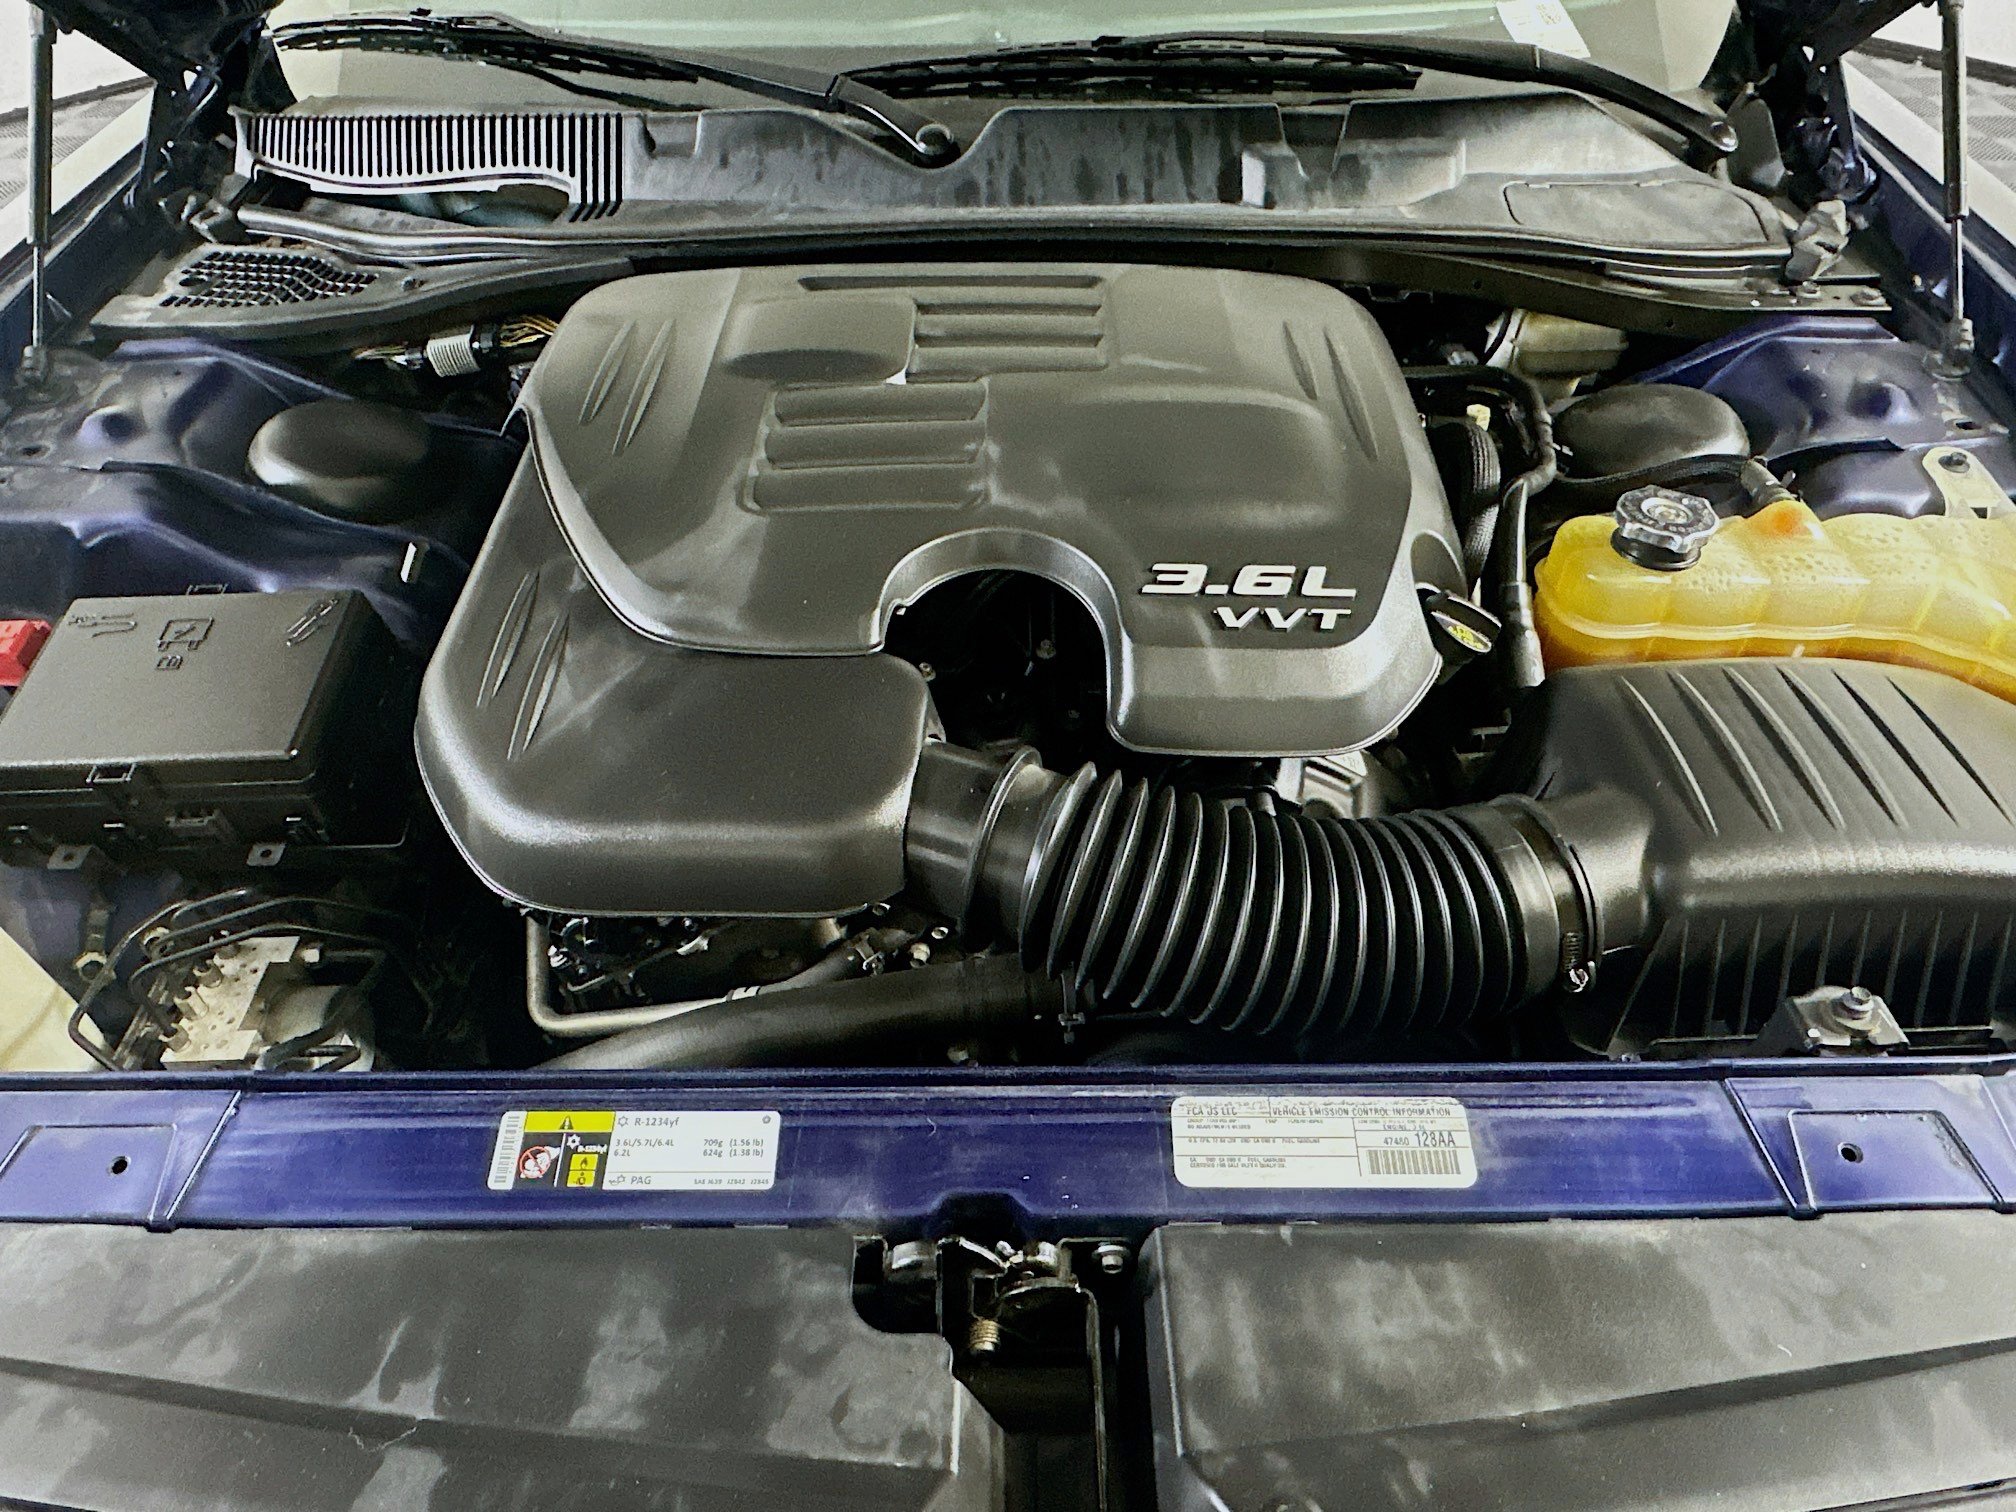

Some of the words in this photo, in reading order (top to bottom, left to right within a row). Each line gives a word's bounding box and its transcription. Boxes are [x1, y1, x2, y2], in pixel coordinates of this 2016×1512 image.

[1140, 563, 1357, 600] 3.6L
[1213, 606, 1352, 632] VVT
[1272, 1107, 1307, 1116] VEHICLE
[1309, 1107, 1349, 1116] EMISSION
[1352, 1106, 1389, 1117] CONTROL
[1392, 1107, 1451, 1116] INFORMATION
[634, 1116, 680, 1128] R-1234yf
[615, 1138, 674, 1148] 3.6L/5.7L/6.4L
[703, 1138, 723, 1148] 709g
[729, 1138, 751, 1148] (1.56
[752, 1138, 764, 1148] lb)
[1414, 1131, 1456, 1147] 128AA
[613, 1148, 631, 1157] 6.2L
[702, 1148, 723, 1158] 624g
[729, 1148, 751, 1158] (1.38
[752, 1148, 764, 1158] lb)
[630, 1175, 652, 1185] PAG
